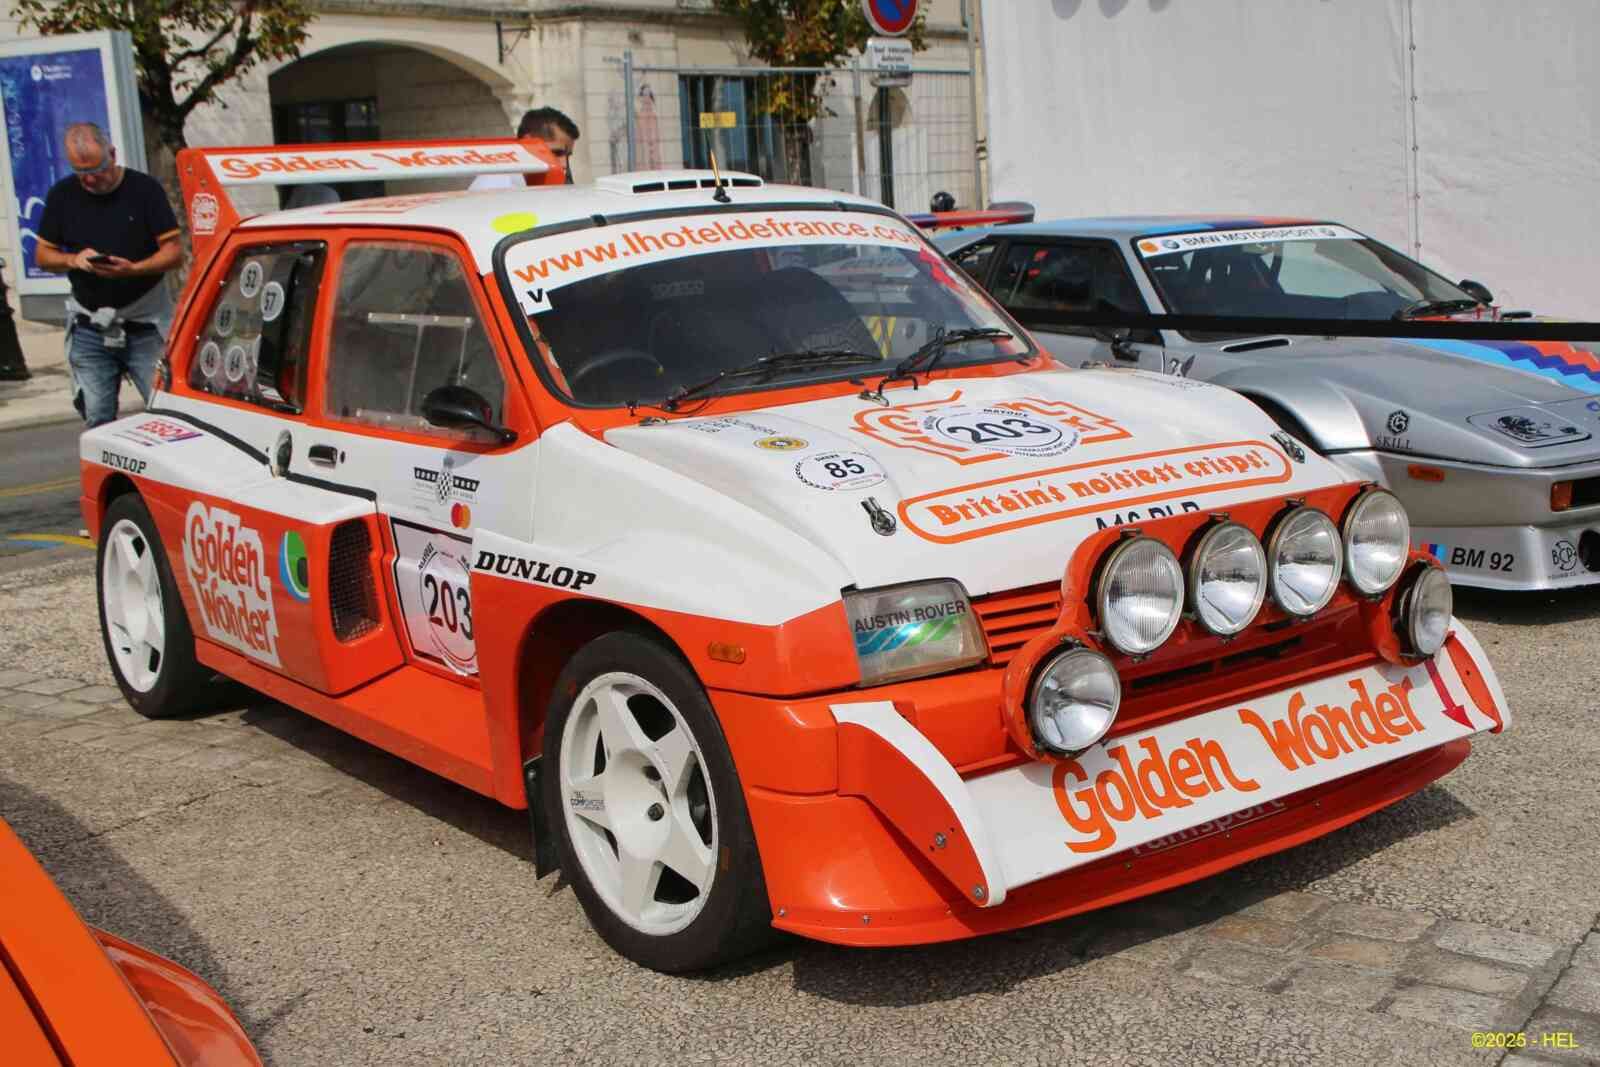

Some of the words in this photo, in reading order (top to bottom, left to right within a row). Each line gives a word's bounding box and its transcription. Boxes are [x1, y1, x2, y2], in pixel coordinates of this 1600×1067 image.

[220, 156, 377, 179] Golden
[372, 149, 520, 169] Wonder
[1183, 234, 1221, 247] BMW
[1222, 228, 1320, 244] MOTORSPORT
[527, 288, 543, 304] V
[947, 418, 1051, 444] 203
[102, 450, 147, 474] DUNLOP
[824, 458, 865, 479] 85
[928, 480, 1061, 526] Britain's
[1068, 461, 1181, 498] noisiest
[1185, 449, 1271, 477] crisps!
[191, 514, 267, 602] Golden
[475, 550, 597, 591] DUNLOP
[1451, 547, 1485, 568] BM
[1489, 552, 1514, 572] 92
[202, 577, 272, 655] Wonder
[425, 573, 473, 641] 203
[855, 609, 912, 632] AUSTIN
[914, 600, 966, 621] ROVER
[1052, 736, 1261, 853] Golden
[1238, 676, 1427, 771] Wonder
